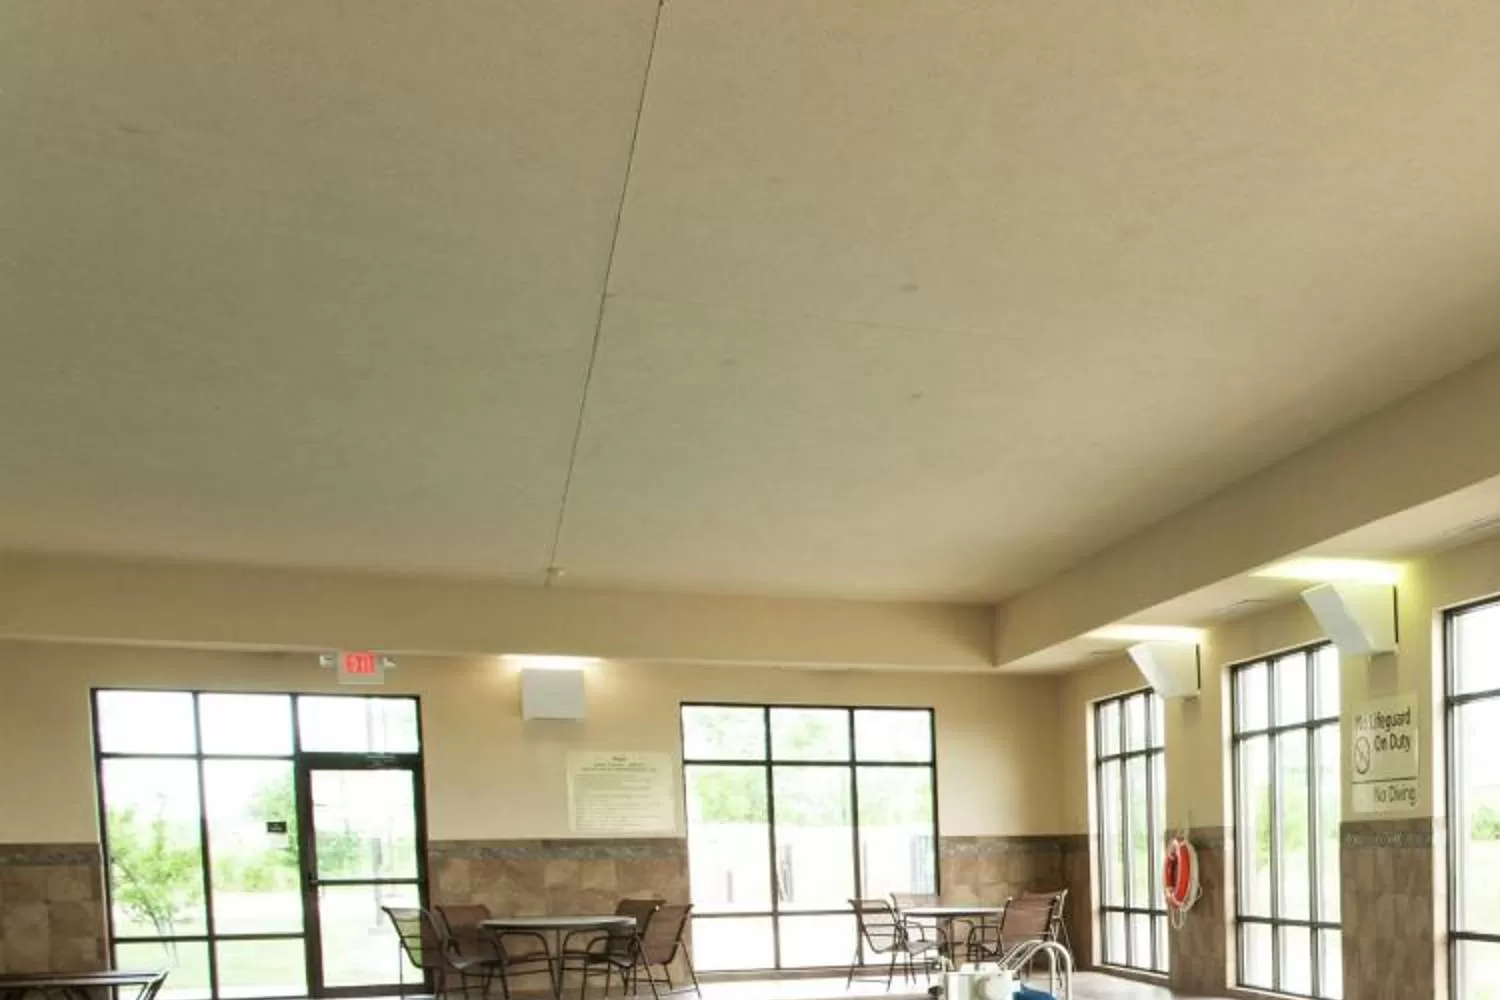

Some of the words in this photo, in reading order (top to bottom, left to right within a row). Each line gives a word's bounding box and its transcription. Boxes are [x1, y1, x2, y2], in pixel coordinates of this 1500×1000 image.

[346, 655, 376, 673] EXIT
[1371, 706, 1411, 732] Lifeguard
[1374, 735, 1386, 752] On
[1389, 732, 1412, 753] Duty
[1374, 787, 1387, 803] No
[1388, 784, 1417, 807] Diving
